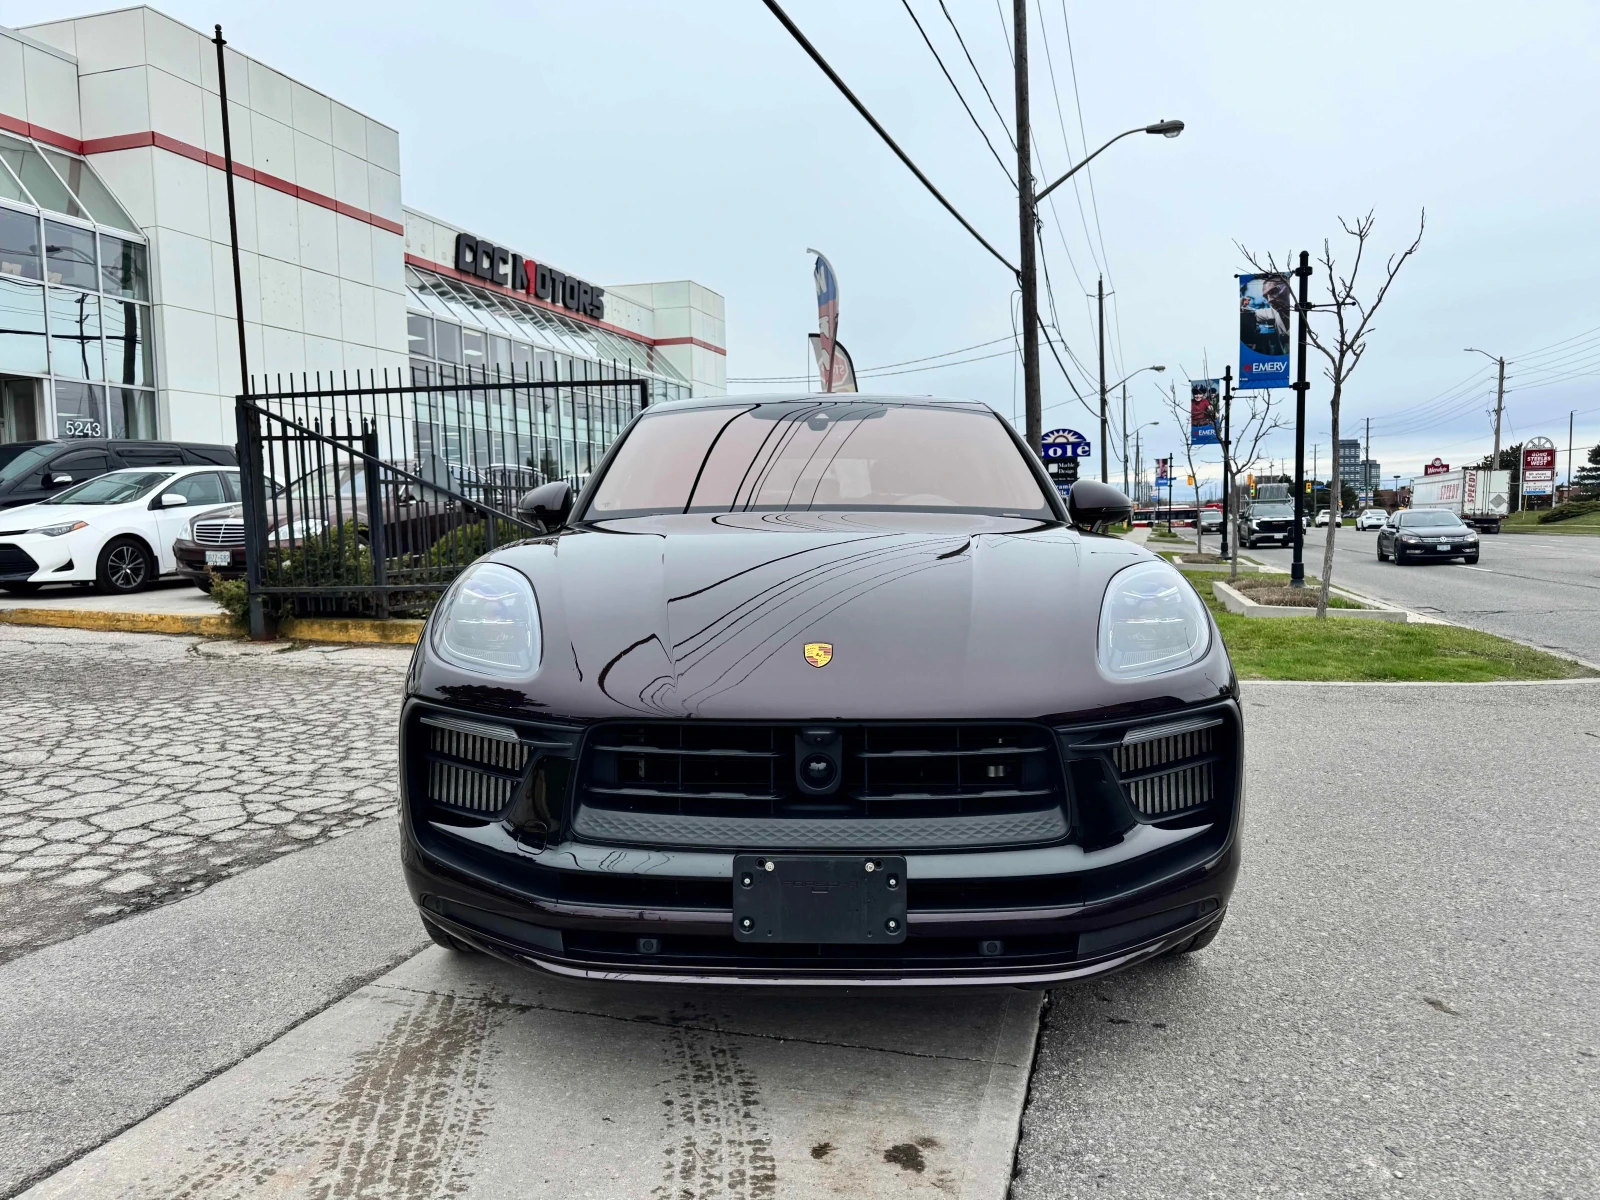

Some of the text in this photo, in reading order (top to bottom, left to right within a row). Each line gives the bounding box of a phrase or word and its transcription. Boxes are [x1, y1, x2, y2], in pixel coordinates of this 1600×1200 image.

[455, 233, 604, 319] CCC MOTORS
[1252, 361, 1288, 373] EMERY
[65, 420, 101, 437] 5243
[1440, 483, 1460, 501] SPEEDY
[1467, 472, 1476, 504] SPEEDY
